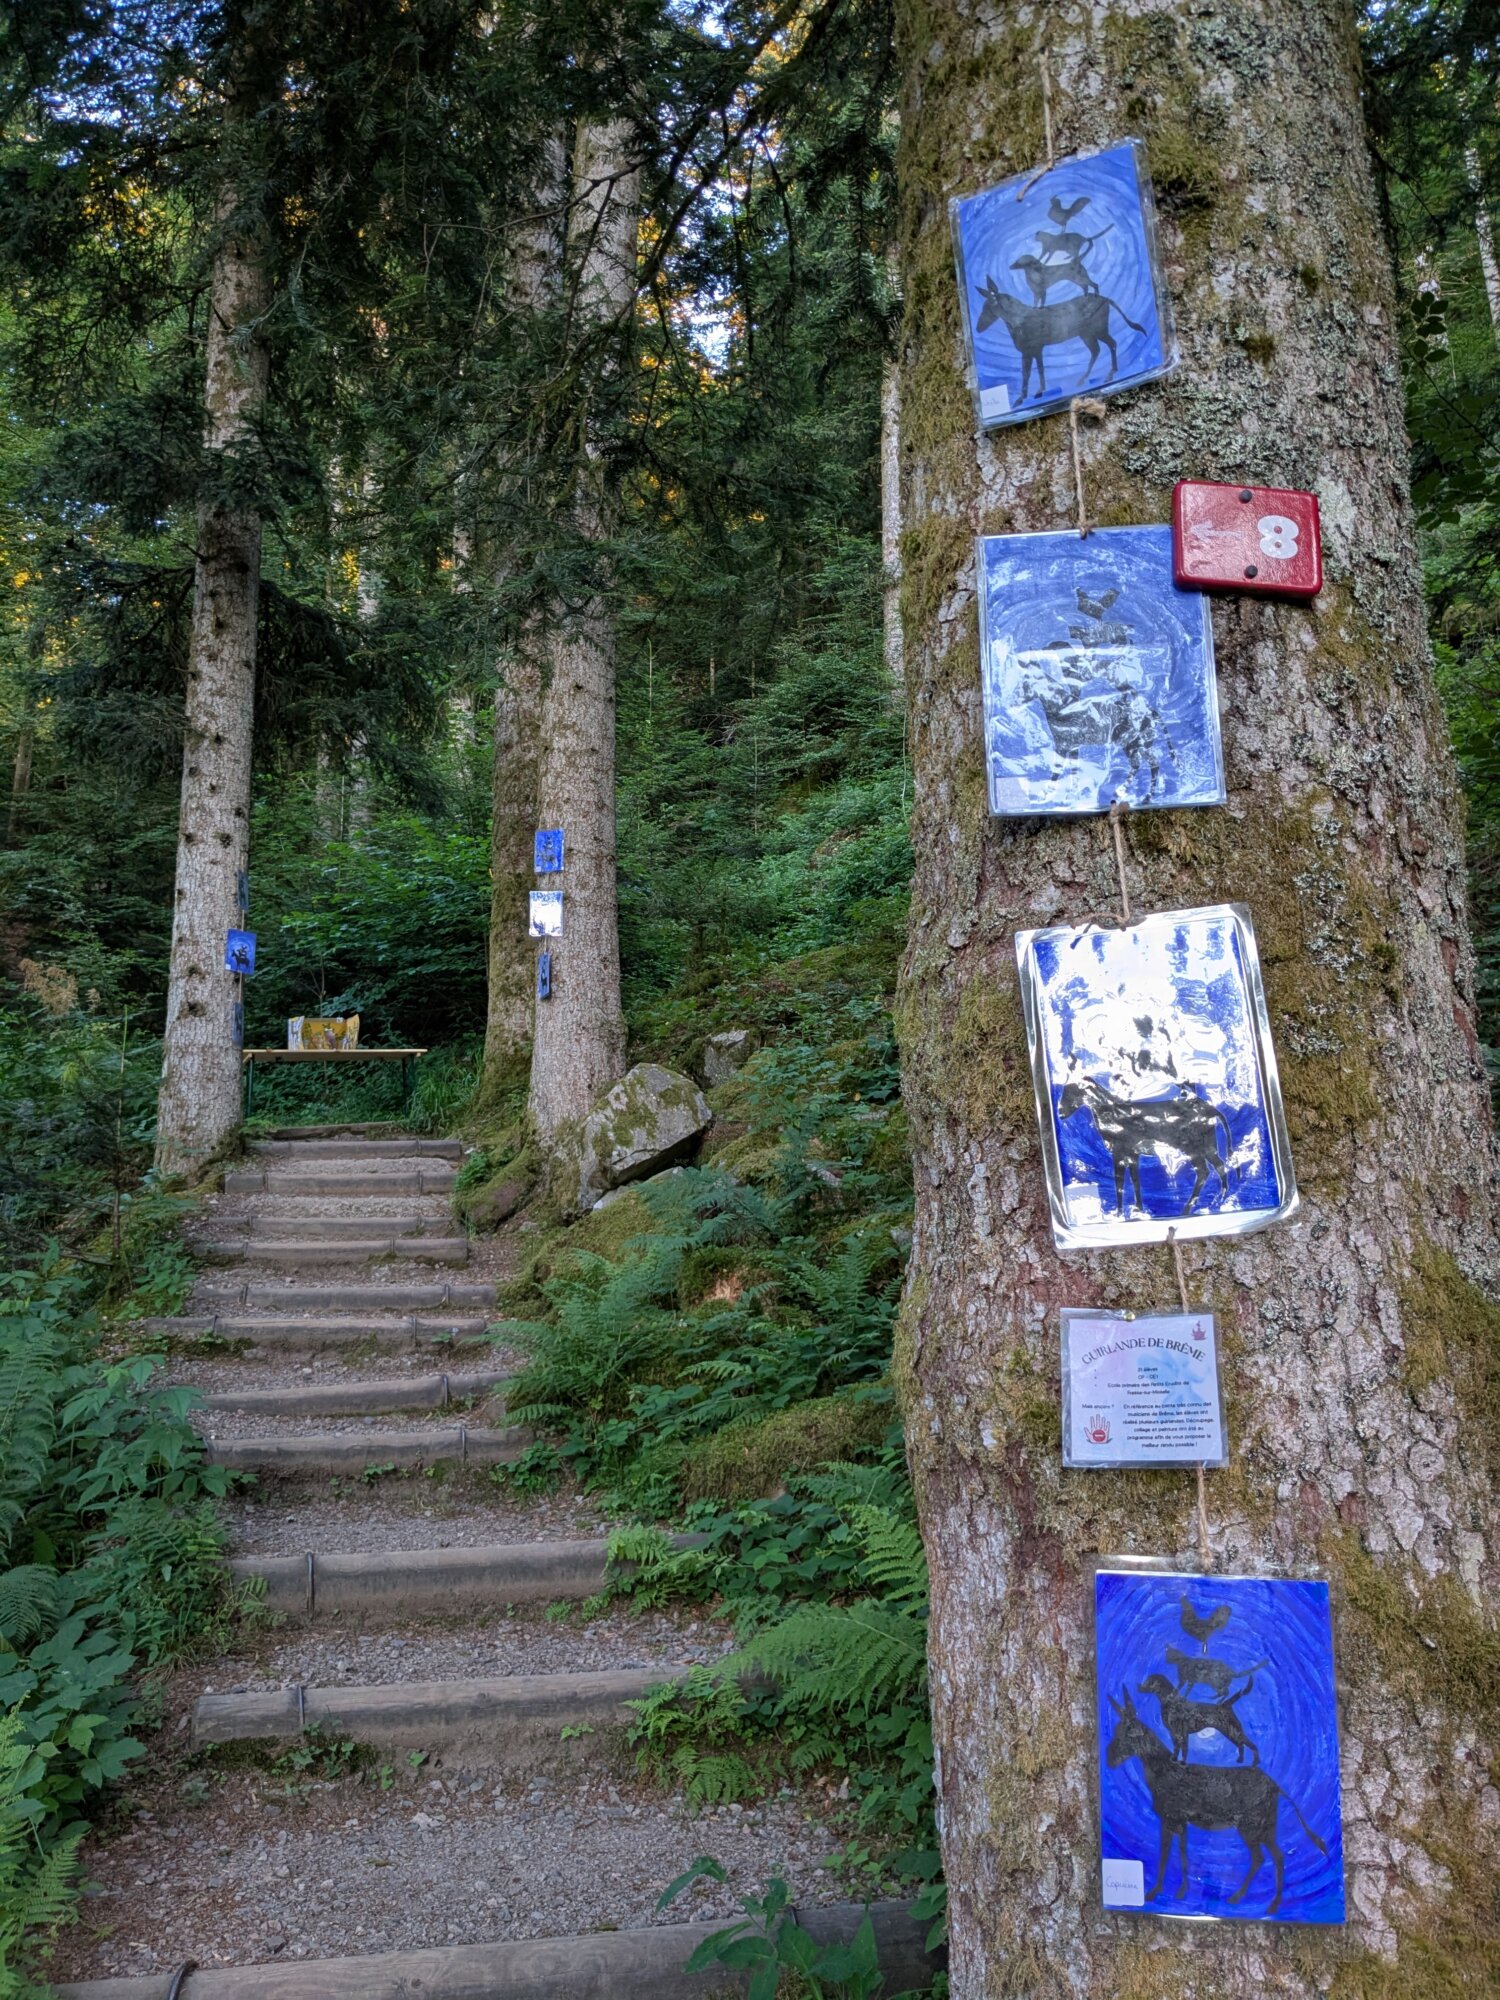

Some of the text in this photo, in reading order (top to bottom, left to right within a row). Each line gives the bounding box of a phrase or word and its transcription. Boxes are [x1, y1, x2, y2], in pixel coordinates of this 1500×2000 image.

[1257, 515, 1299, 559] 8
[1081, 1337, 1206, 1364] GUIRLANDE DE BRÊME
